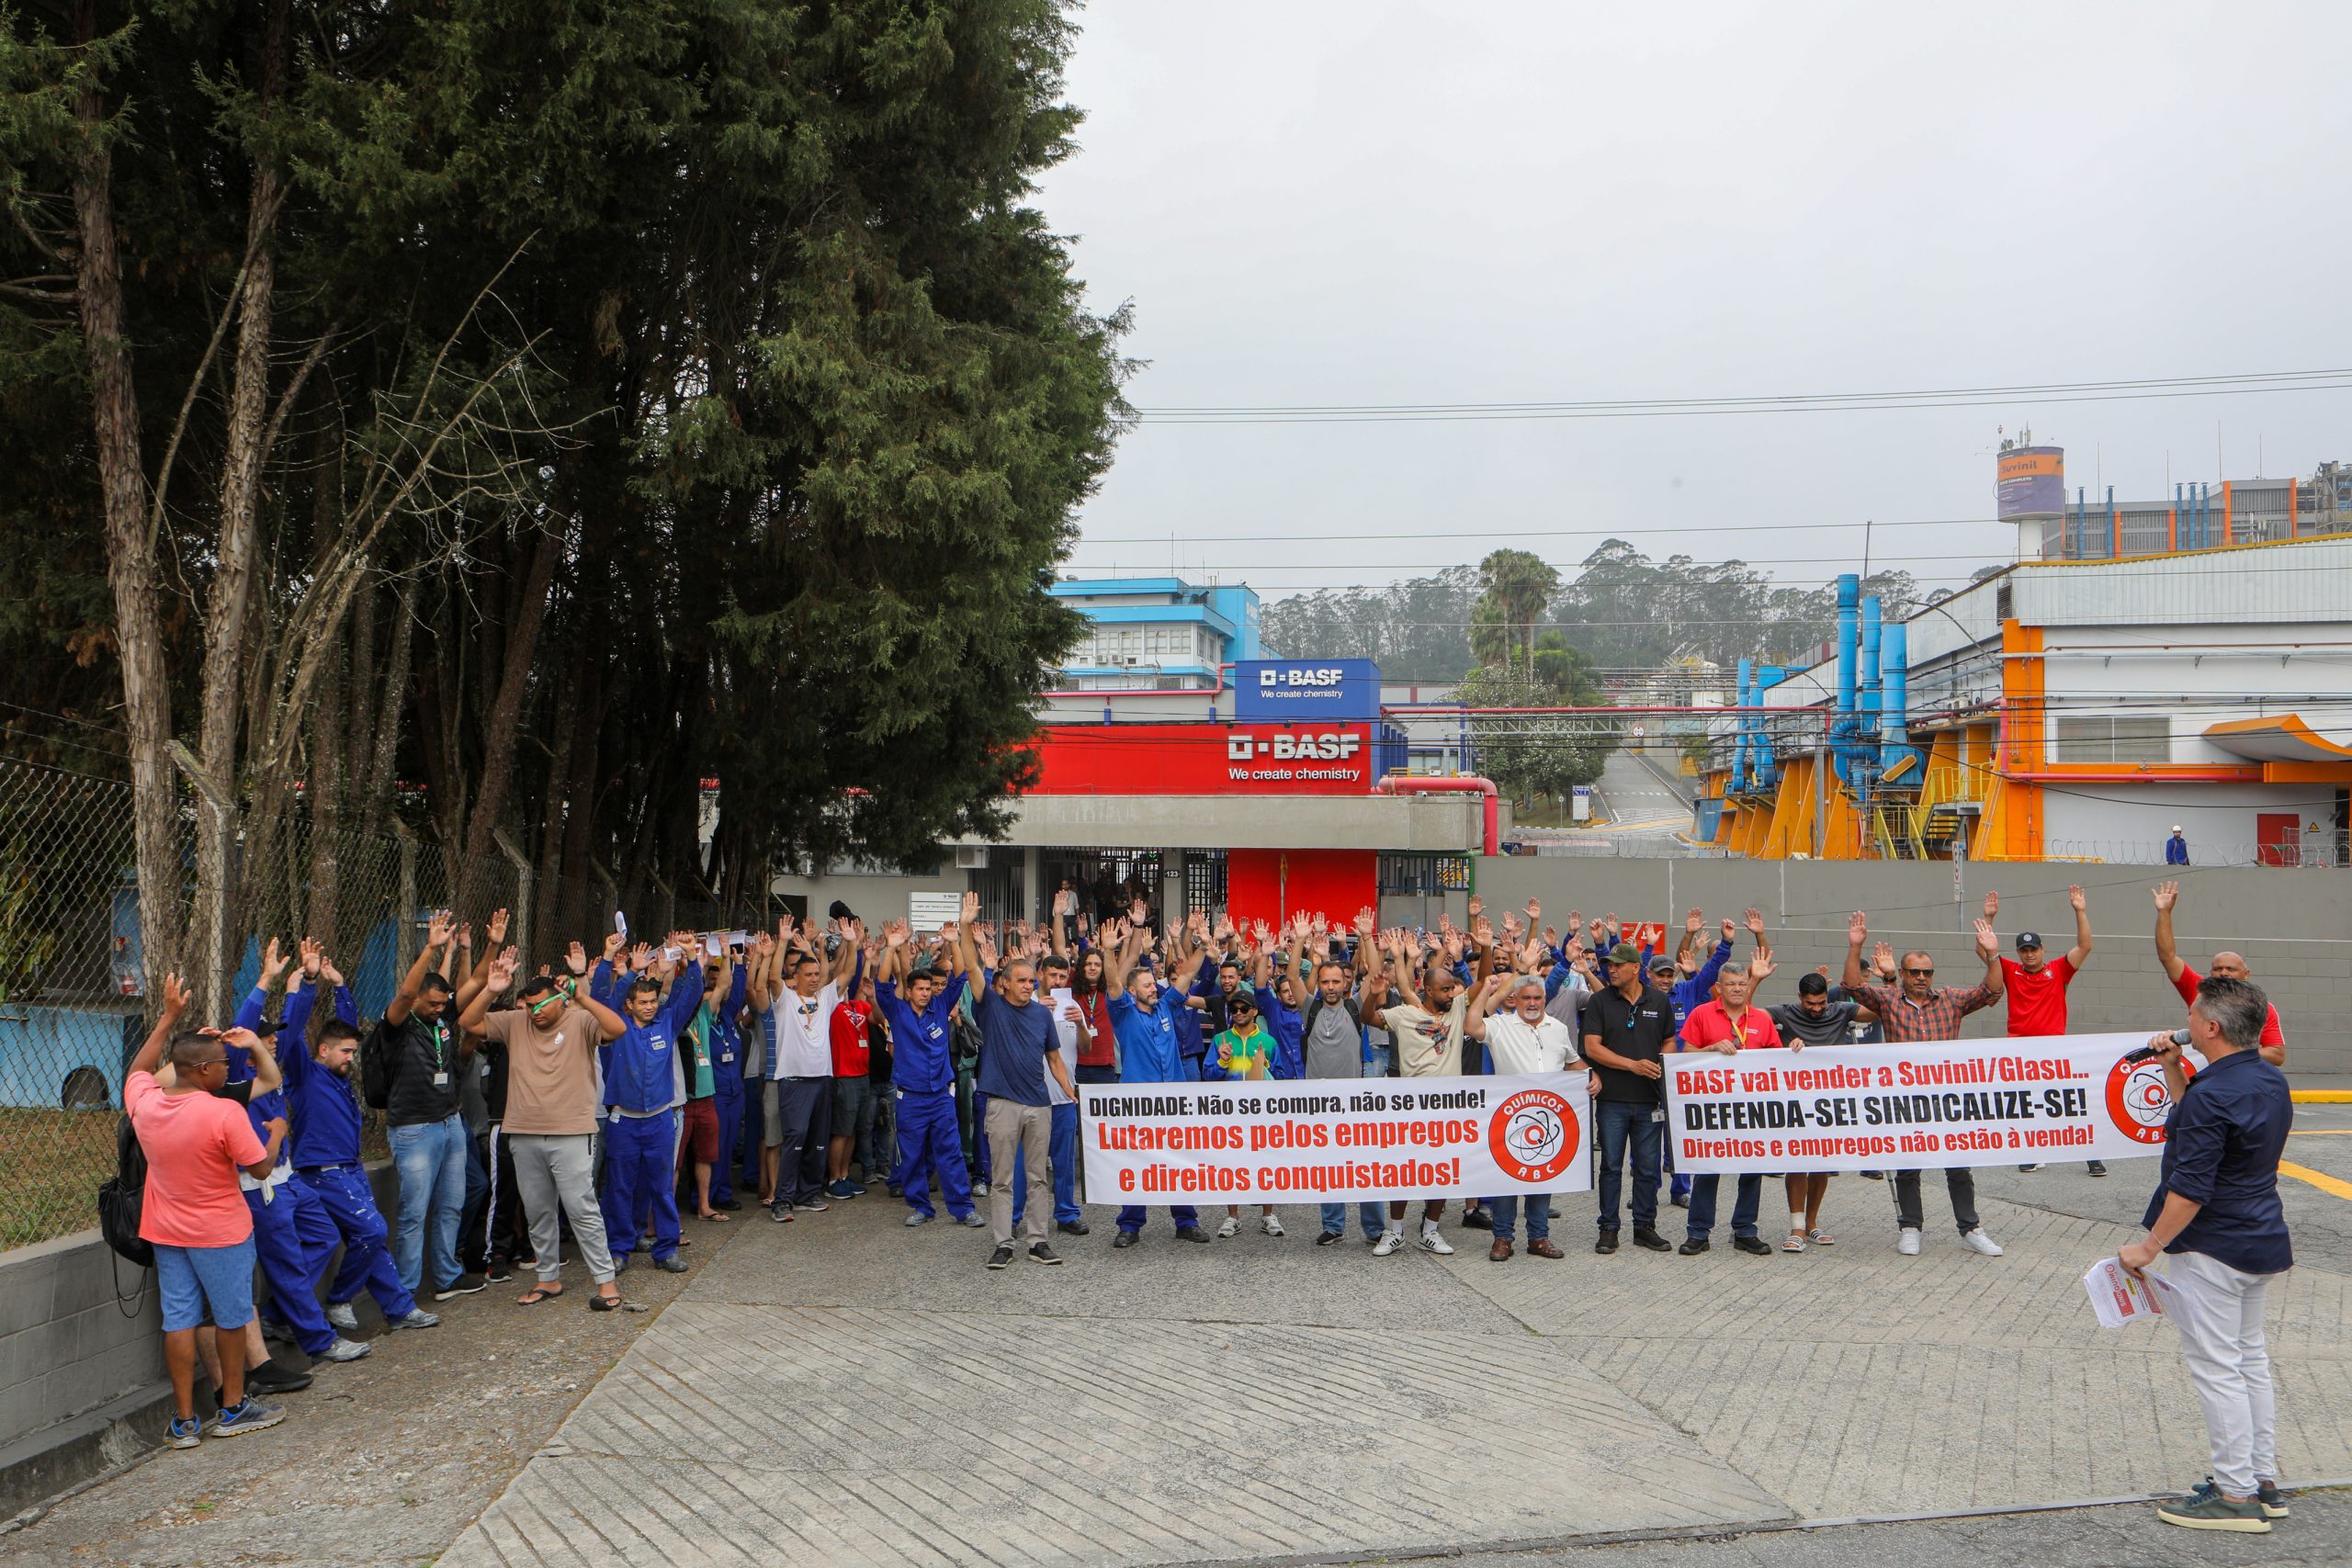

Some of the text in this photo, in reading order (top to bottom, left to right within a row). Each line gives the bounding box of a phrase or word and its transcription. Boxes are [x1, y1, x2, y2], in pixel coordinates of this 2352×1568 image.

[2001, 460, 2037, 473] Suvinil
[1288, 669, 1342, 686] BASF
[1261, 690, 1274, 698] We
[1304, 690, 1343, 699] chemistry
[1273, 733, 1360, 760] BASF
[1228, 767, 1360, 782] We create chemistry
[1676, 1069, 1736, 1095] BASF
[1740, 1067, 1779, 1093] vai
[1782, 1065, 1871, 1090] vender
[1877, 1066, 1894, 1088] a
[1897, 1056, 2090, 1087] Suvinil/Glasu...
[1089, 1089, 1487, 1117] DIGNIDADE: Não se compra, não se vende!
[1503, 1093, 1564, 1116] QUÍMICOS
[1684, 1088, 2088, 1131] DEFENDA-SE! SINDICALIZE-SE!
[1098, 1119, 1480, 1152] Lutaremos pelos empregos
[1682, 1124, 2095, 1158] Direitos e empregos não estão à venda!
[1119, 1157, 1461, 1193] e direitos conquistados!
